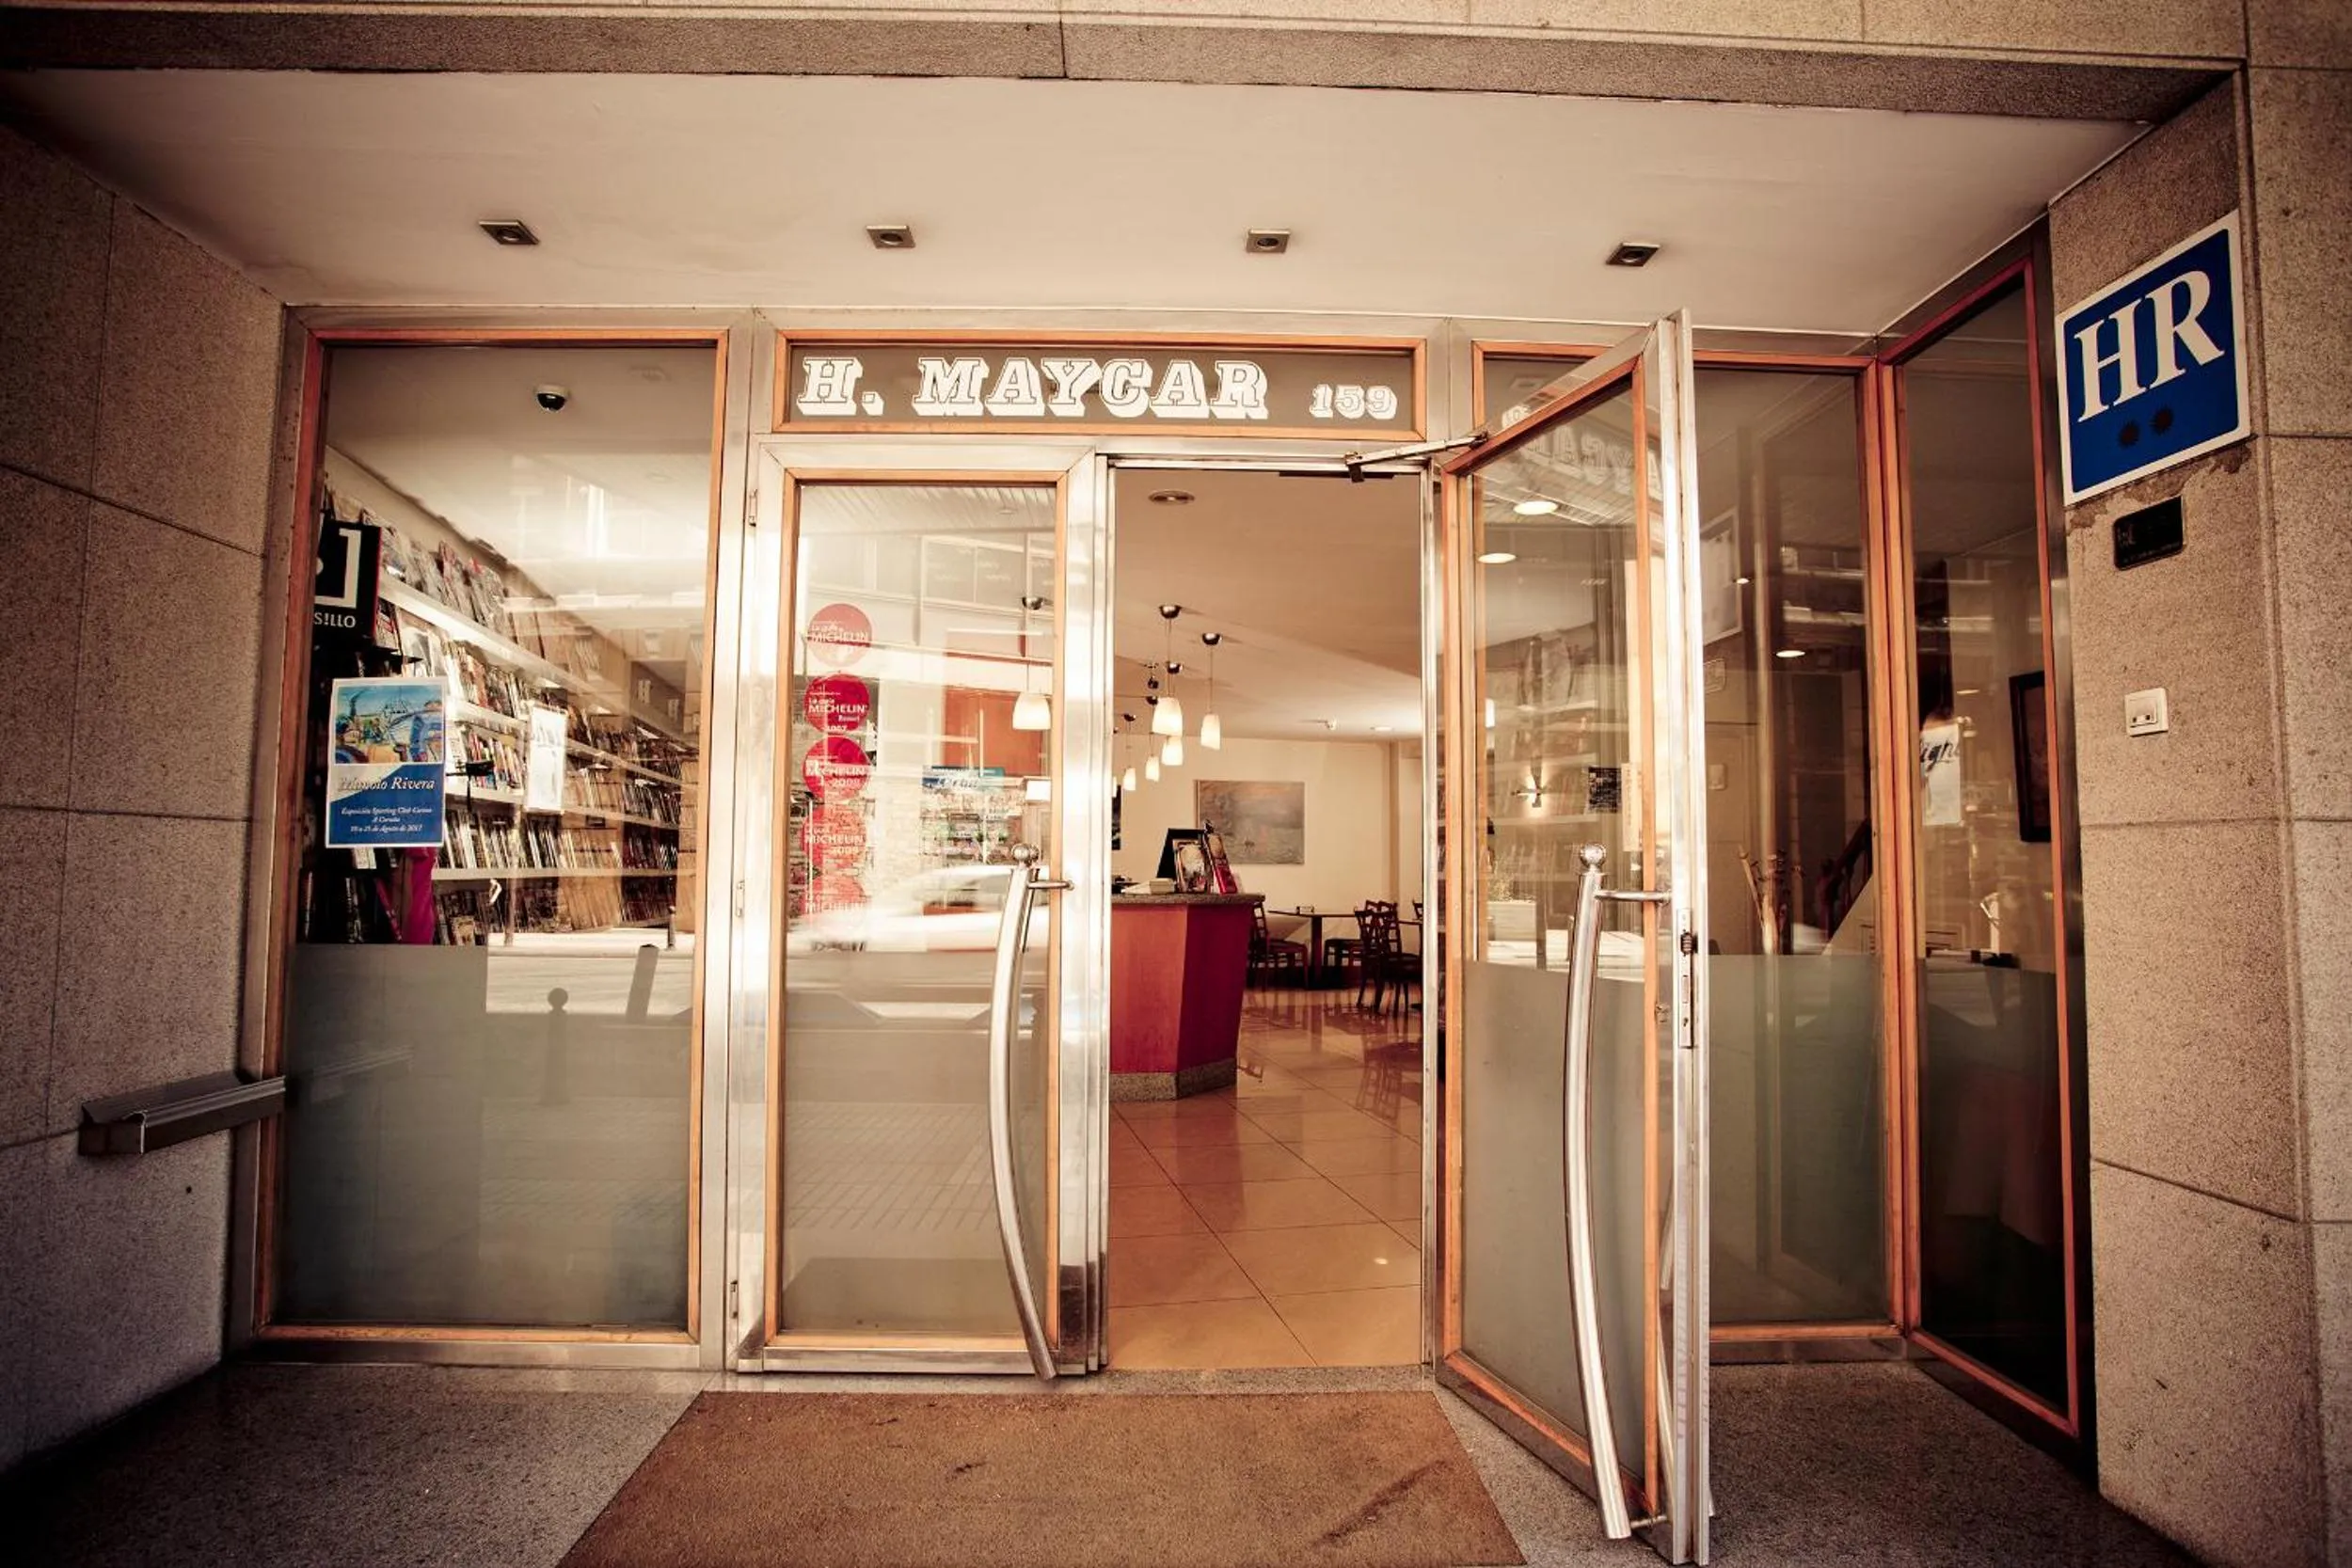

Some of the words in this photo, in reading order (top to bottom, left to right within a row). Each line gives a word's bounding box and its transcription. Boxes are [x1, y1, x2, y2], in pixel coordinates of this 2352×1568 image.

[2074, 269, 2226, 423] HR
[796, 356, 884, 416] H.
[913, 356, 1269, 420] MAYCAR
[1309, 383, 1398, 420] 159
[808, 704, 865, 713] MICHELIN
[806, 766, 866, 776] CHELIN
[391, 776, 435, 790] Rivera
